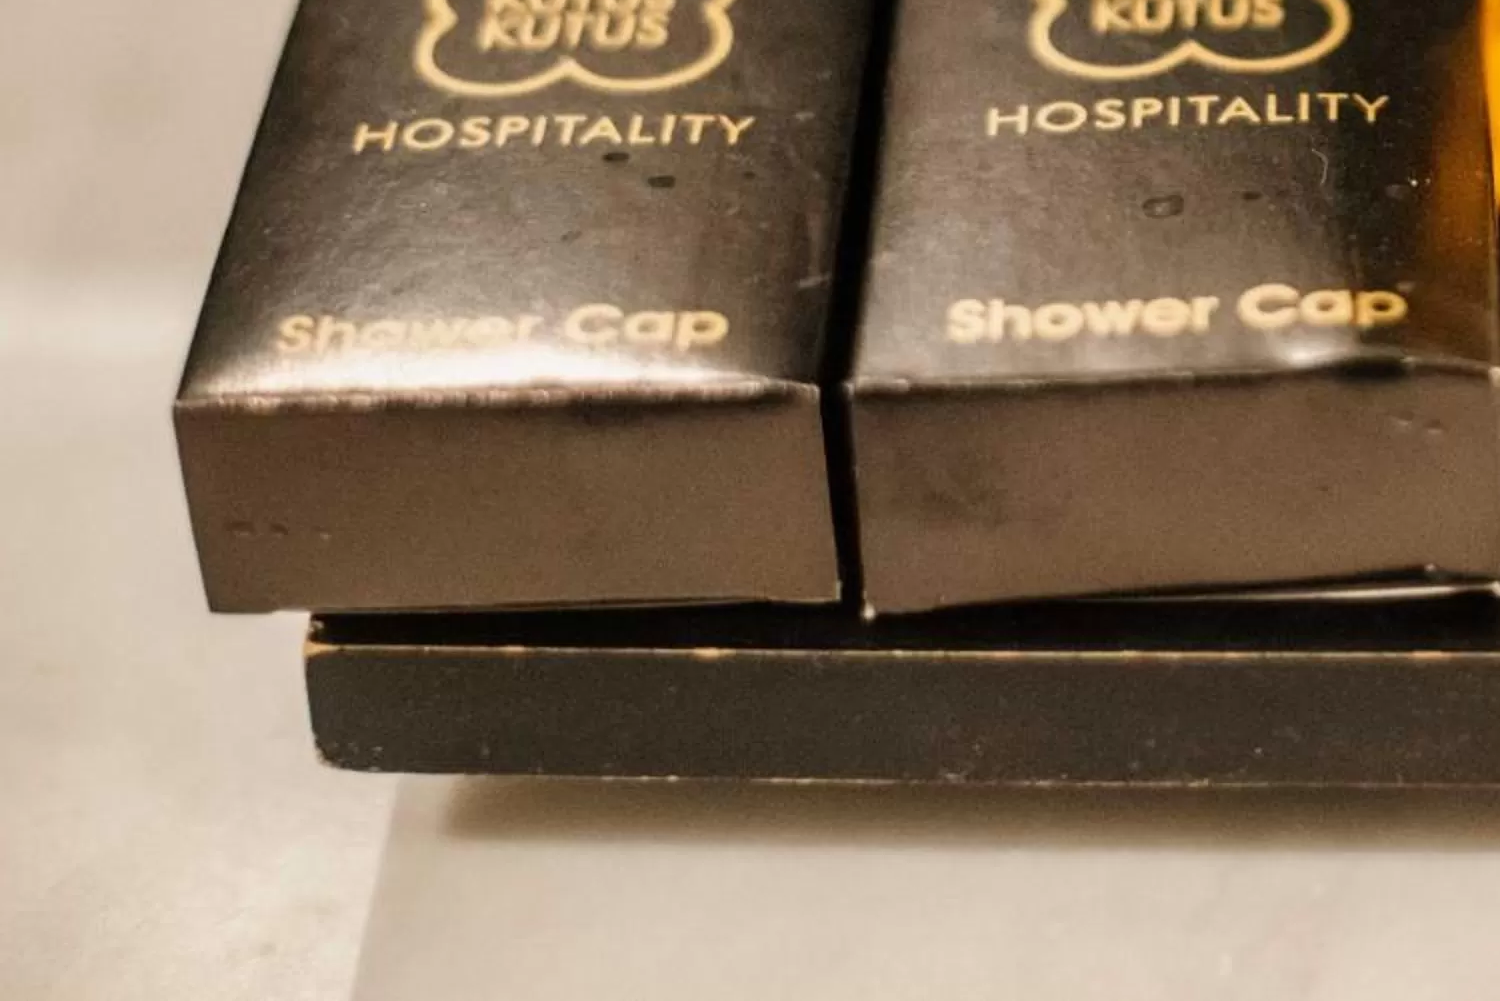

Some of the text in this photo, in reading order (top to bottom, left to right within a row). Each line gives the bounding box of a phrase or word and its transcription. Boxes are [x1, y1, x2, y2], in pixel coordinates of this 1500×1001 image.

[479, 12, 671, 52] KUTUS
[353, 113, 756, 153] HOSPITALITY
[986, 92, 1390, 136] HOSPITALITY
[565, 303, 729, 349] Cap
[946, 283, 1407, 343] Shower Cap
